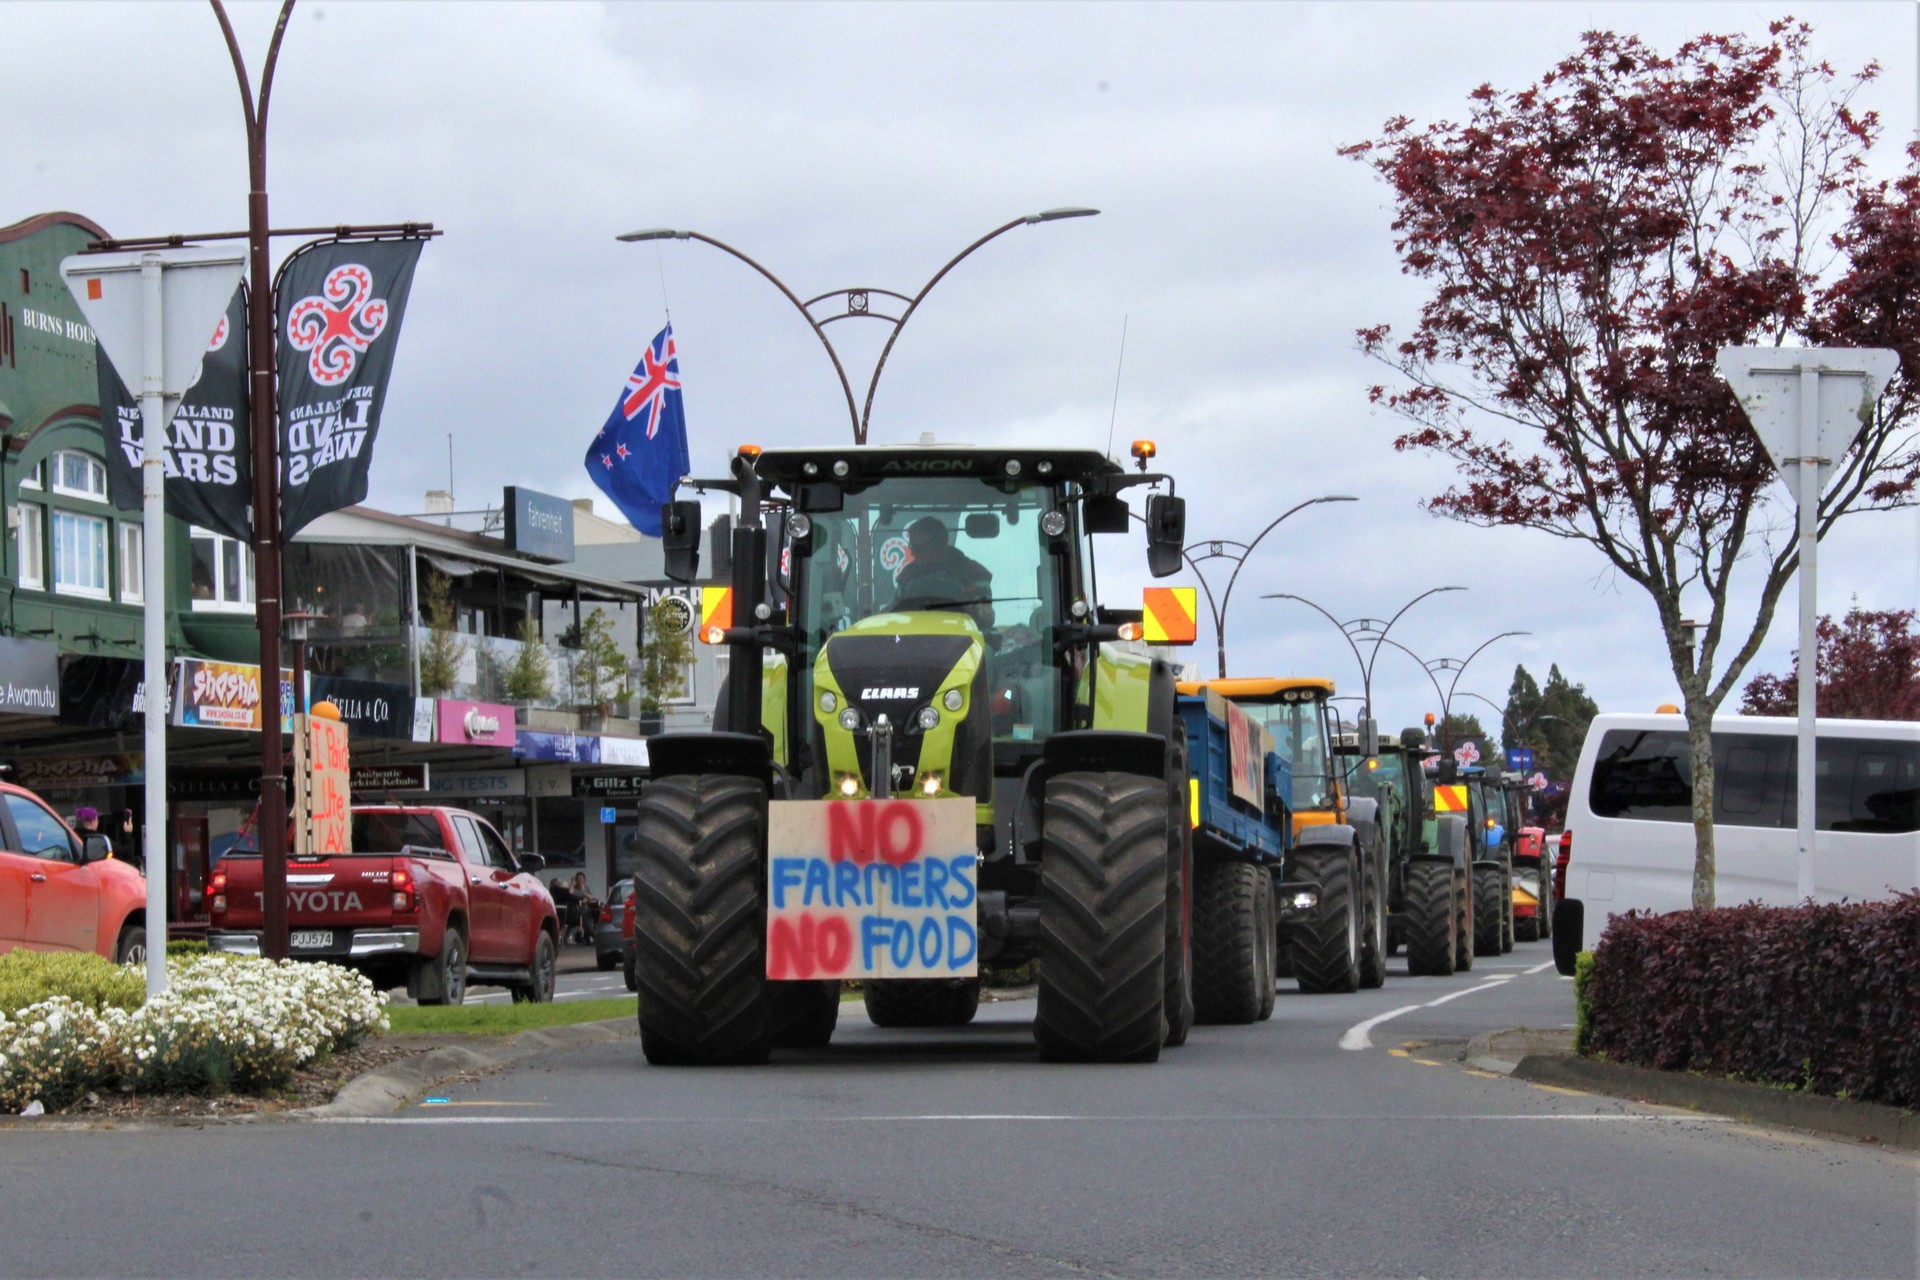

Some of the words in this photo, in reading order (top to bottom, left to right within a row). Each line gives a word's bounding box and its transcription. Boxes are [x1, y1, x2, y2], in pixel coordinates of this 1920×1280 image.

[23, 308, 63, 336] BURNS
[66, 320, 97, 346] HOUS
[117, 405, 140, 420] NE
[176, 404, 234, 420] ALAND
[881, 460, 974, 471] AXION
[7, 682, 55, 708] Awamutu
[861, 687, 919, 700] CLAAS
[366, 701, 371, 717] &
[311, 720, 324, 771] I
[325, 726, 349, 773] Paid
[355, 769, 402, 779] Authentic
[383, 777, 418, 786] Kebabs
[430, 777, 453, 791] NG
[459, 775, 508, 790] TESTS
[593, 777, 628, 788] Gillz
[312, 814, 347, 856] TAX
[827, 801, 924, 866] NO
[772, 855, 976, 910] FARMERS
[254, 891, 363, 912] TYOTA
[291, 932, 332, 945] PJJ574
[767, 911, 853, 979] NO
[861, 914, 977, 970] FOOD
